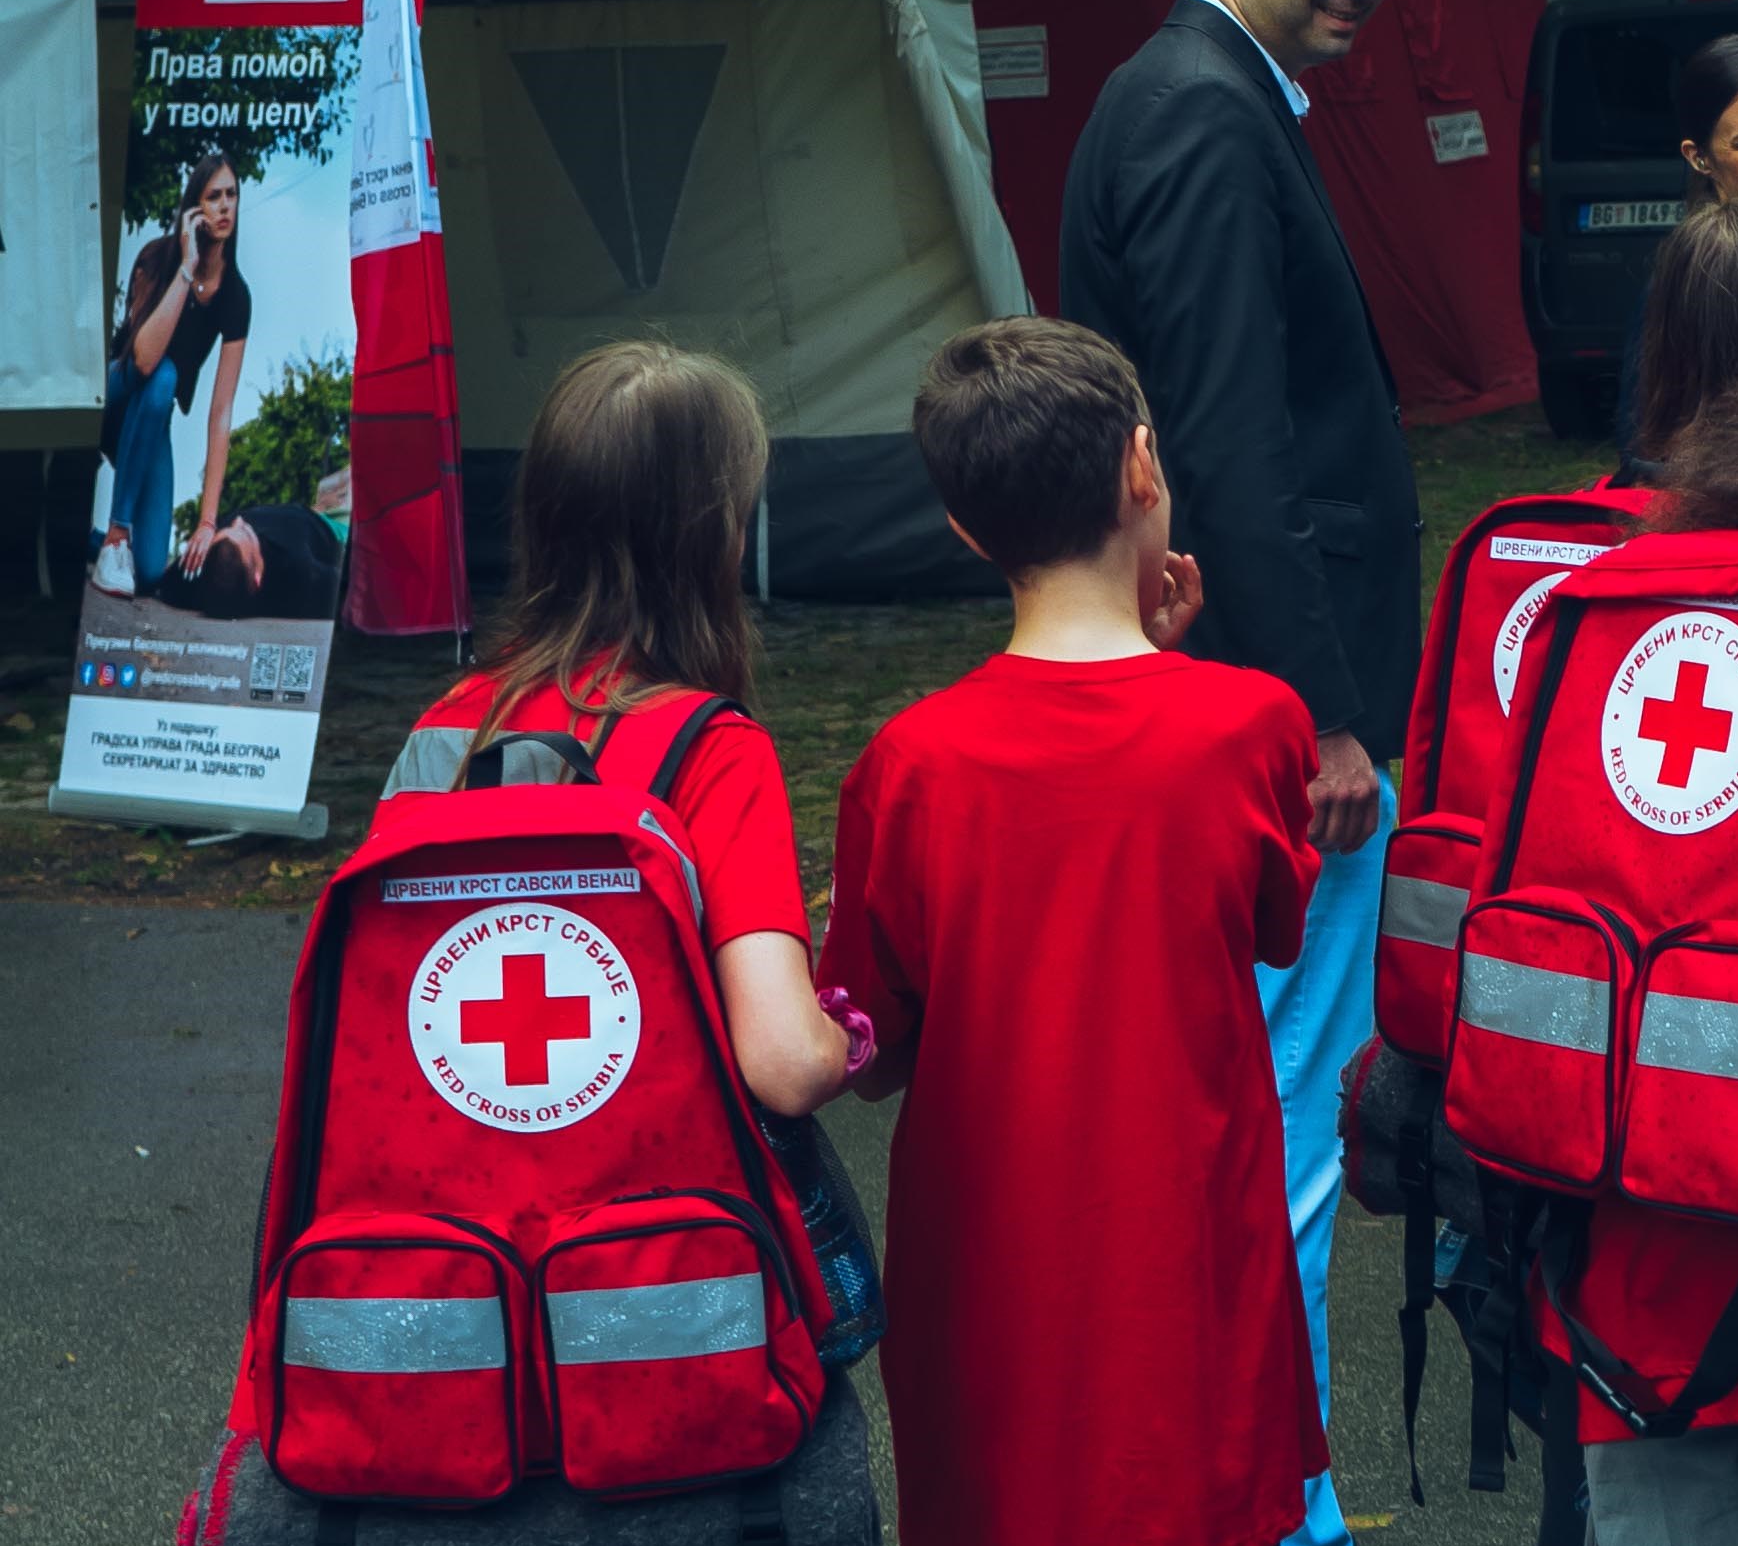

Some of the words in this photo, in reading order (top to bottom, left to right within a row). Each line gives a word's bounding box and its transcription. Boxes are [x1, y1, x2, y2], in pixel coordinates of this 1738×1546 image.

[149, 47, 223, 86] Прва
[231, 46, 326, 78] помоћ
[143, 103, 159, 135] у
[167, 103, 240, 127] твом
[247, 102, 318, 135] џепу
[1591, 204, 1613, 226] BG
[1495, 541, 1543, 558] ЦРВЕНИ
[1545, 546, 1575, 560] КРСТ
[1618, 627, 1676, 695] ЦРВЕНИ
[1682, 622, 1725, 645] КРСТ
[91, 731, 139, 749] ГРАДСКА
[142, 736, 182, 752] УПРАВА
[184, 739, 221, 755] ГРАДА
[223, 742, 280, 760] БЕОГРАДА
[183, 759, 198, 774] ЗА
[201, 759, 266, 779] ЗДРАВСТВО
[1610, 746, 1627, 784] RED
[1624, 784, 1667, 824] CROSS
[1670, 810, 1691, 825] OF
[385, 882, 454, 900] ЦРВЕНИ
[460, 878, 501, 896] КРСТ
[505, 874, 572, 893] САВСКИ
[578, 872, 636, 890] ВЕНАЦ
[420, 922, 492, 1004] ЦРВЕНИ
[496, 913, 555, 935] КРСТ
[560, 922, 629, 997] СРБИЈЕ
[431, 1055, 465, 1095] RED
[465, 1091, 532, 1124] CROSS
[536, 1104, 563, 1123] OF
[565, 1052, 624, 1113] SERBIA
